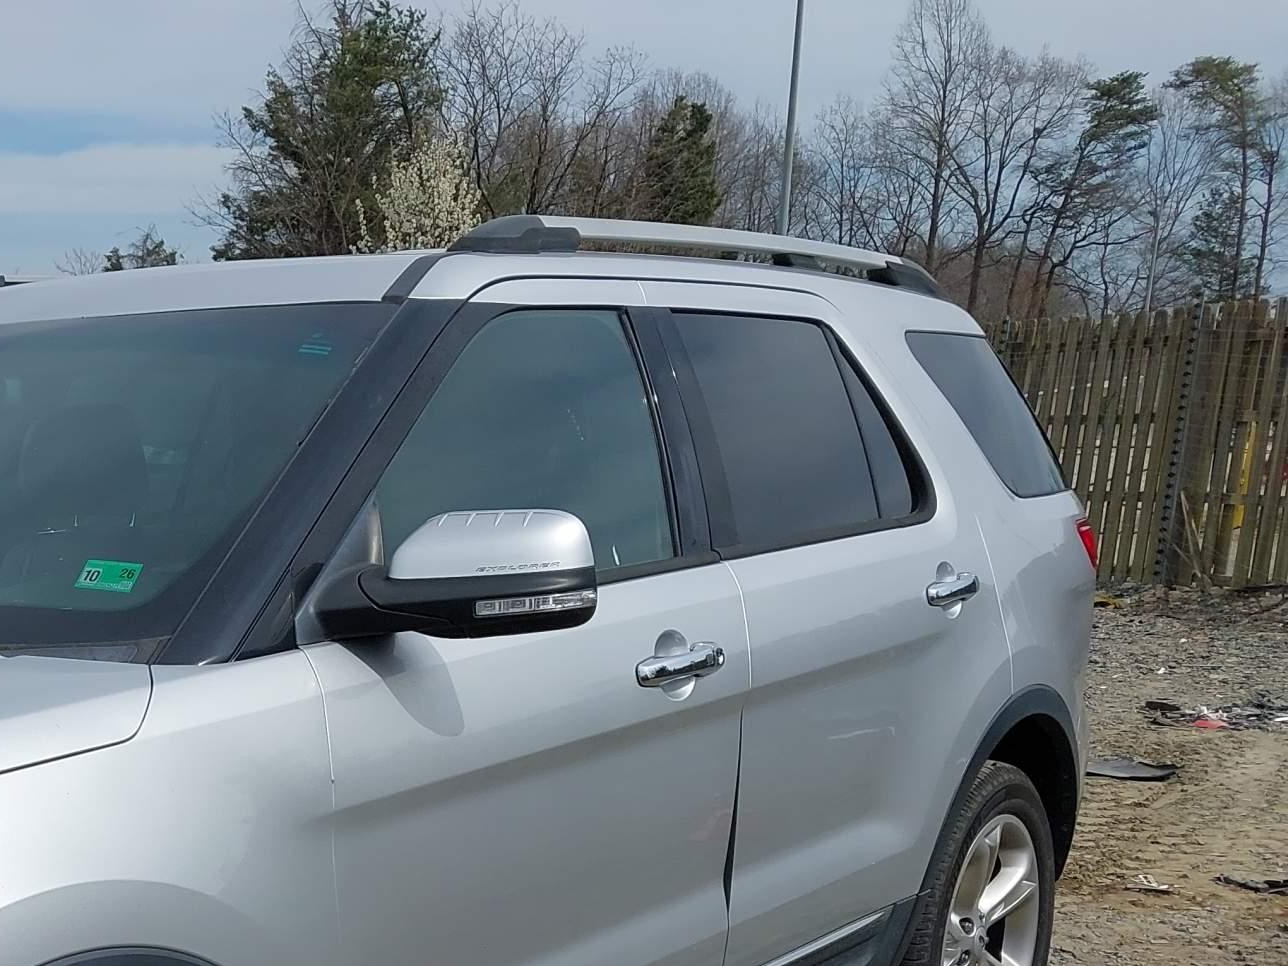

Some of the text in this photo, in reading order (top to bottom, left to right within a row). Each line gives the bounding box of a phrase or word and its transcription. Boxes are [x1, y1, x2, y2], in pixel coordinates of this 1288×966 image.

[475, 561, 560, 572] EXPLORER
[83, 568, 136, 582] 10 26
